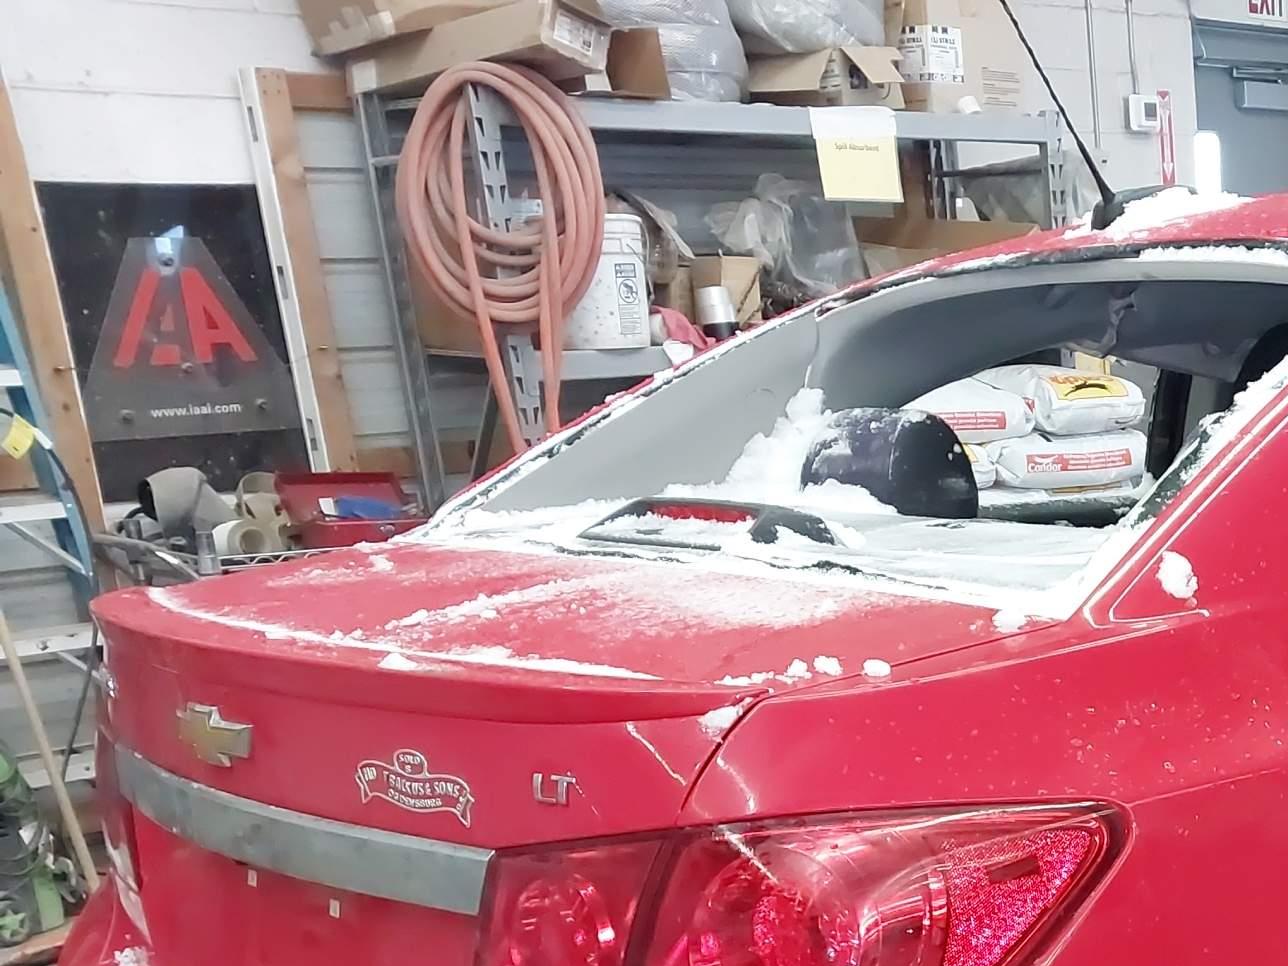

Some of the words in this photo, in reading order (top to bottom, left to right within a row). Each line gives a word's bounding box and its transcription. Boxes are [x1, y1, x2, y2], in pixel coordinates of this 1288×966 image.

[150, 402, 242, 418] www.iaai.com
[1027, 462, 1062, 473] Condor
[433, 781, 460, 797] SONS
[532, 772, 574, 806] LT
